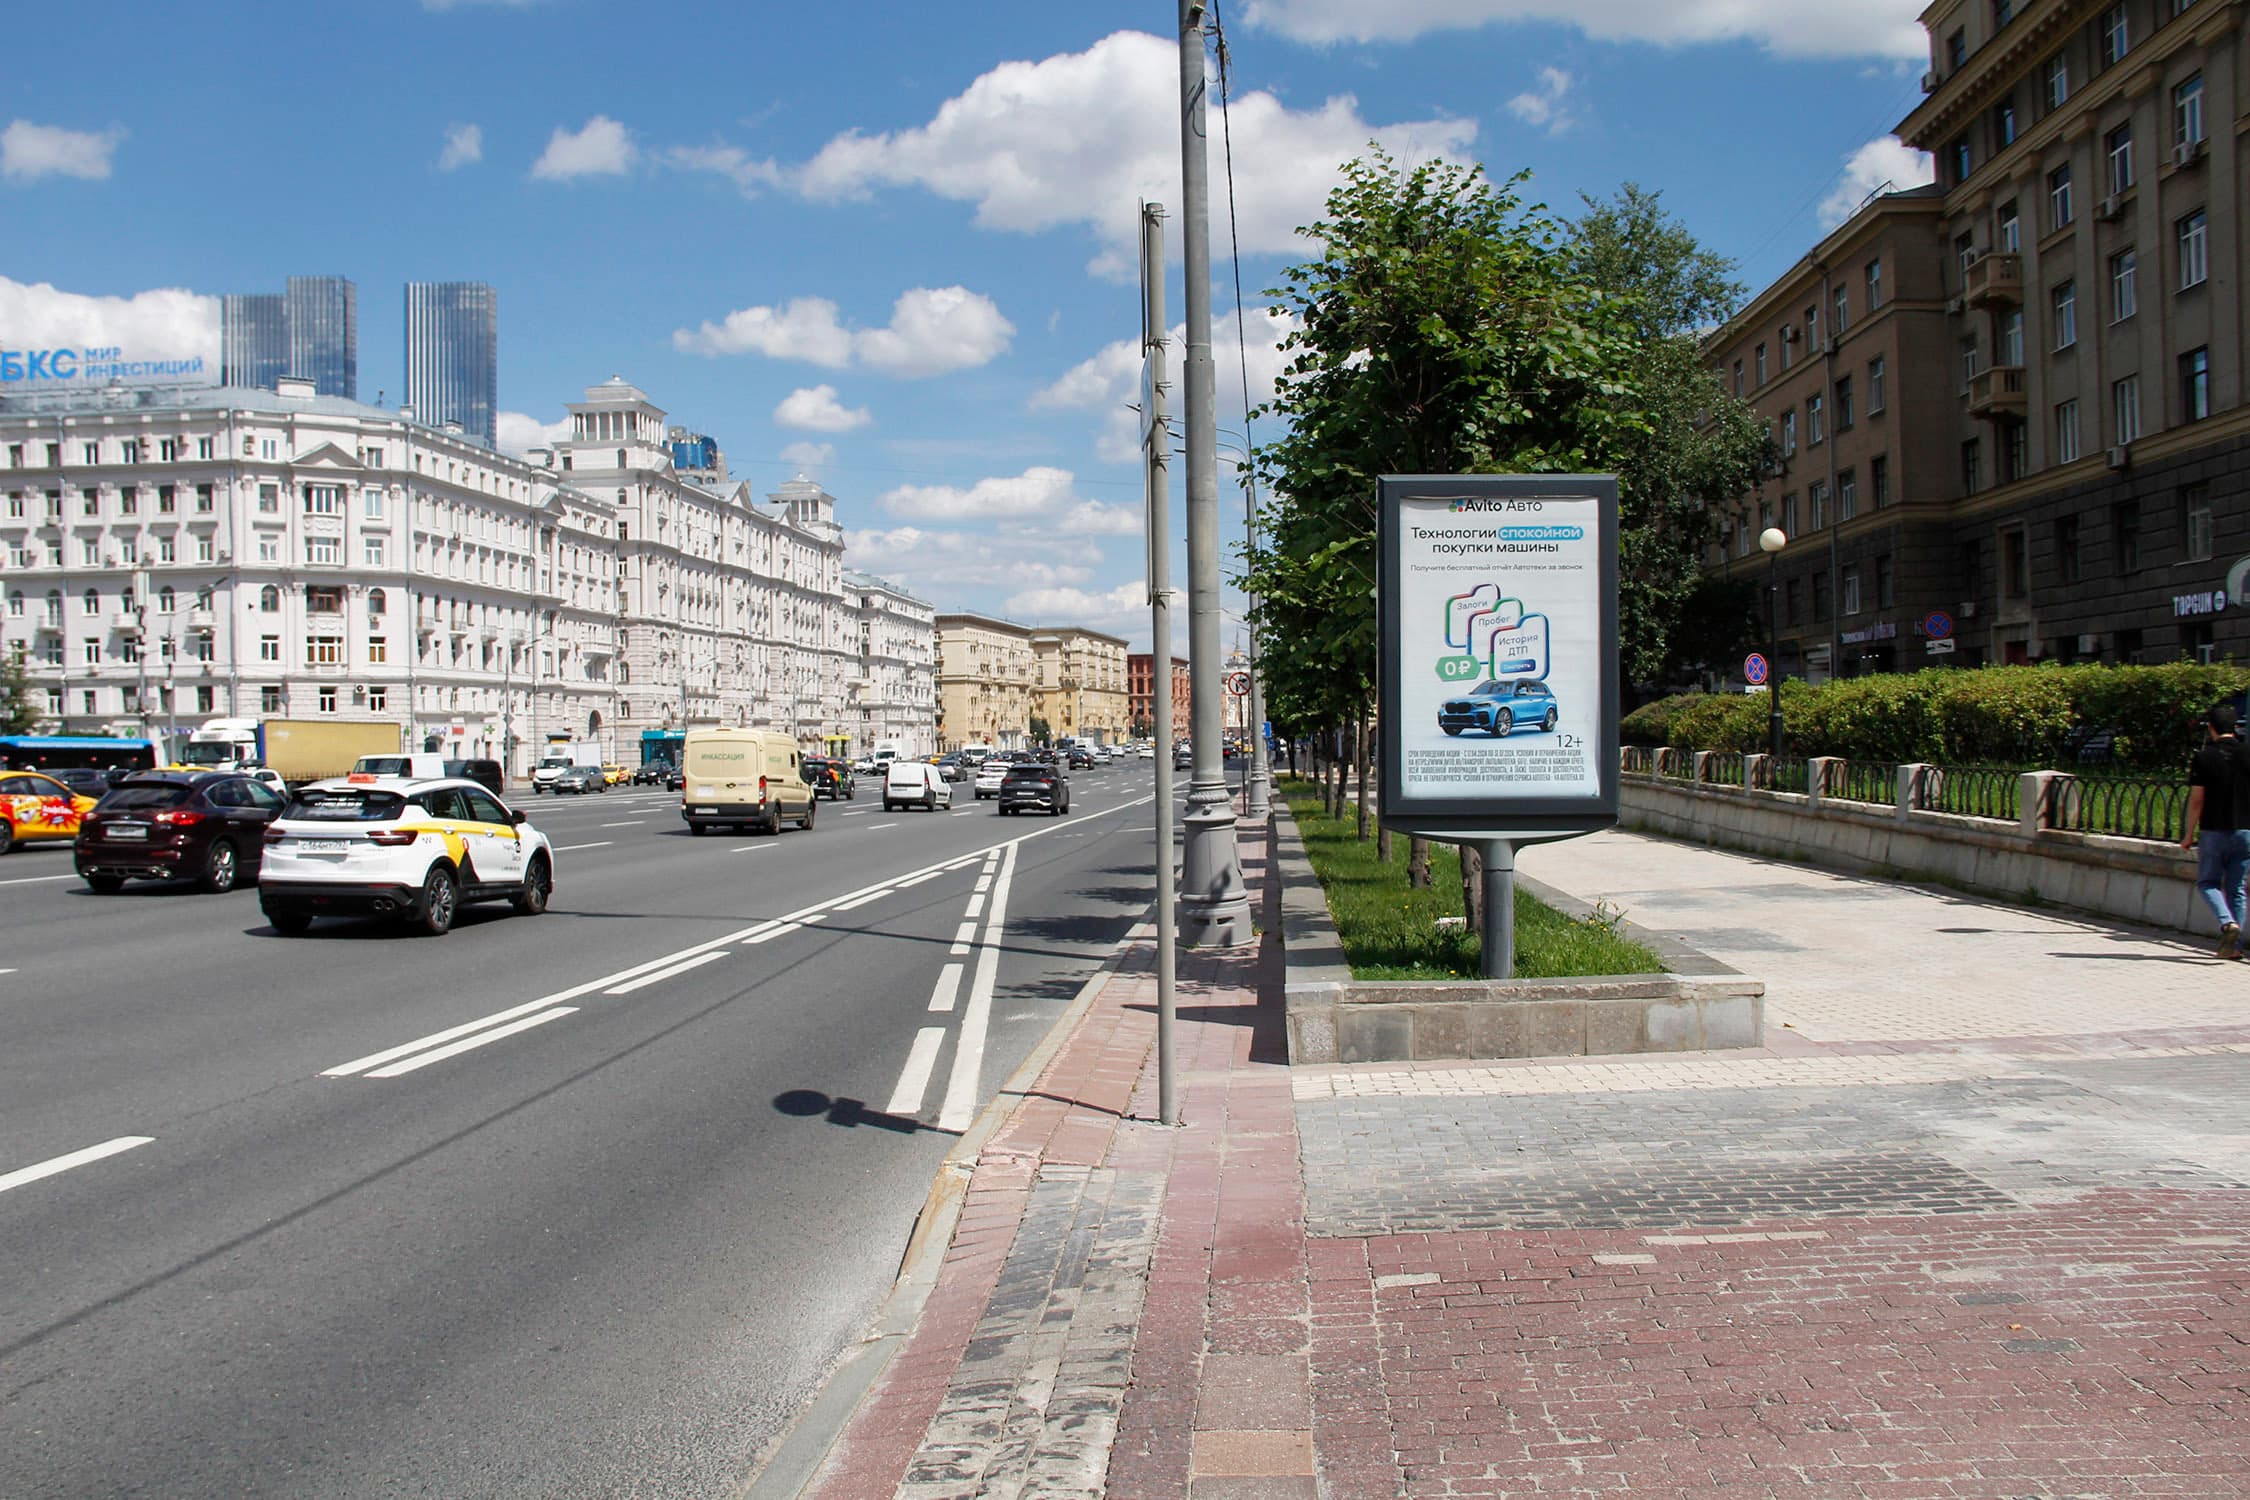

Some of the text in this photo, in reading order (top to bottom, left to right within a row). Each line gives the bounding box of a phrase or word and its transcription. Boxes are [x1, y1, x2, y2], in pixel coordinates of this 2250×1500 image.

[1, 347, 121, 382] БКС МИР
[85, 357, 203, 377] ИНВЕСТИЦИЙ
[1464, 499, 1543, 512] Avito Авто
[1411, 526, 1581, 540] Технологии спокойной
[1432, 543, 1559, 556] покупки машины
[1410, 564, 1446, 572] Получите
[1446, 564, 1490, 572] бесплатный
[1456, 600, 1488, 611] Залоги
[1478, 615, 1512, 627] Пробег
[1499, 634, 1538, 646] История
[1508, 646, 1528, 657] ДТП
[1556, 735, 1583, 748] 12+
[701, 752, 745, 761] ИНКАССАЦИЯ
